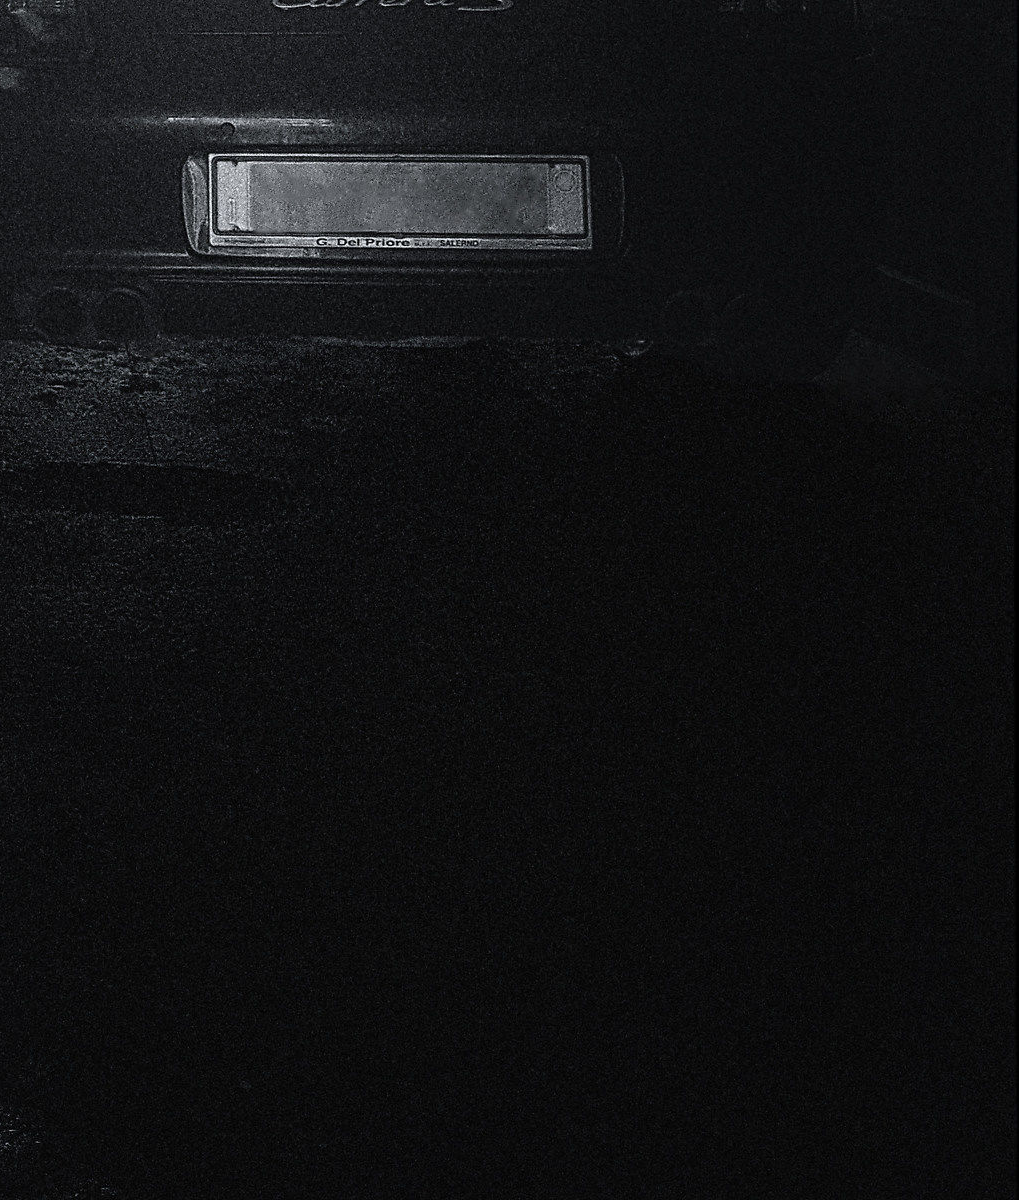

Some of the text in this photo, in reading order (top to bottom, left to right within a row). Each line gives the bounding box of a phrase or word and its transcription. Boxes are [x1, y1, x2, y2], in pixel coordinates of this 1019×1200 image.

[316, 238, 332, 247] G.
[337, 238, 360, 247] Del
[365, 238, 410, 247] Priore
[440, 239, 480, 247] SALERNO
